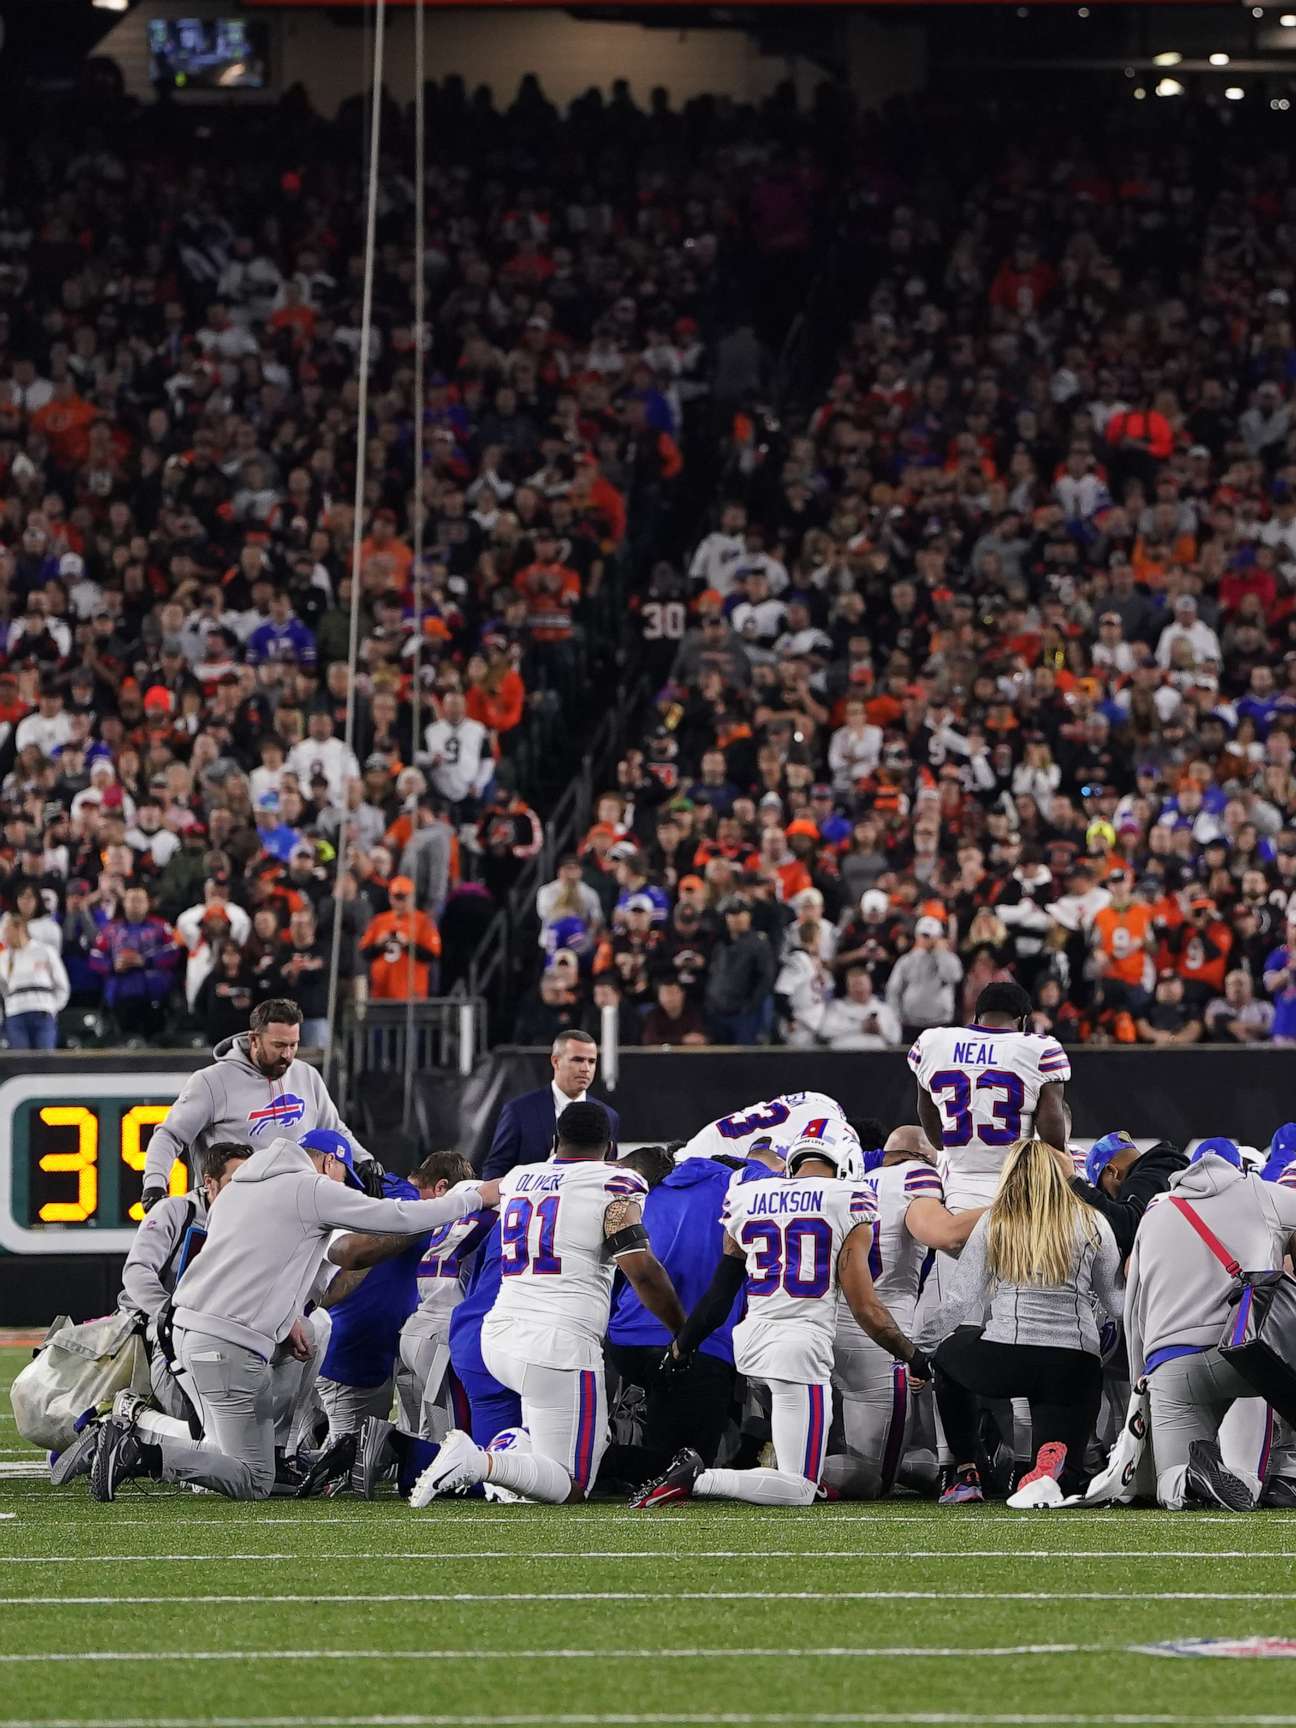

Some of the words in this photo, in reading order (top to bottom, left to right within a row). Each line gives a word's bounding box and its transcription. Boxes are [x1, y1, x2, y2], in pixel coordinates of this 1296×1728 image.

[641, 602, 685, 639] 30
[446, 738, 459, 763] 9
[953, 1042, 998, 1064] NEAL
[929, 1069, 1024, 1147] 33
[515, 1174, 563, 1192] OLIVER
[747, 1191, 823, 1215] JACKSON
[501, 1196, 561, 1276] 91
[741, 1218, 832, 1298] 30
